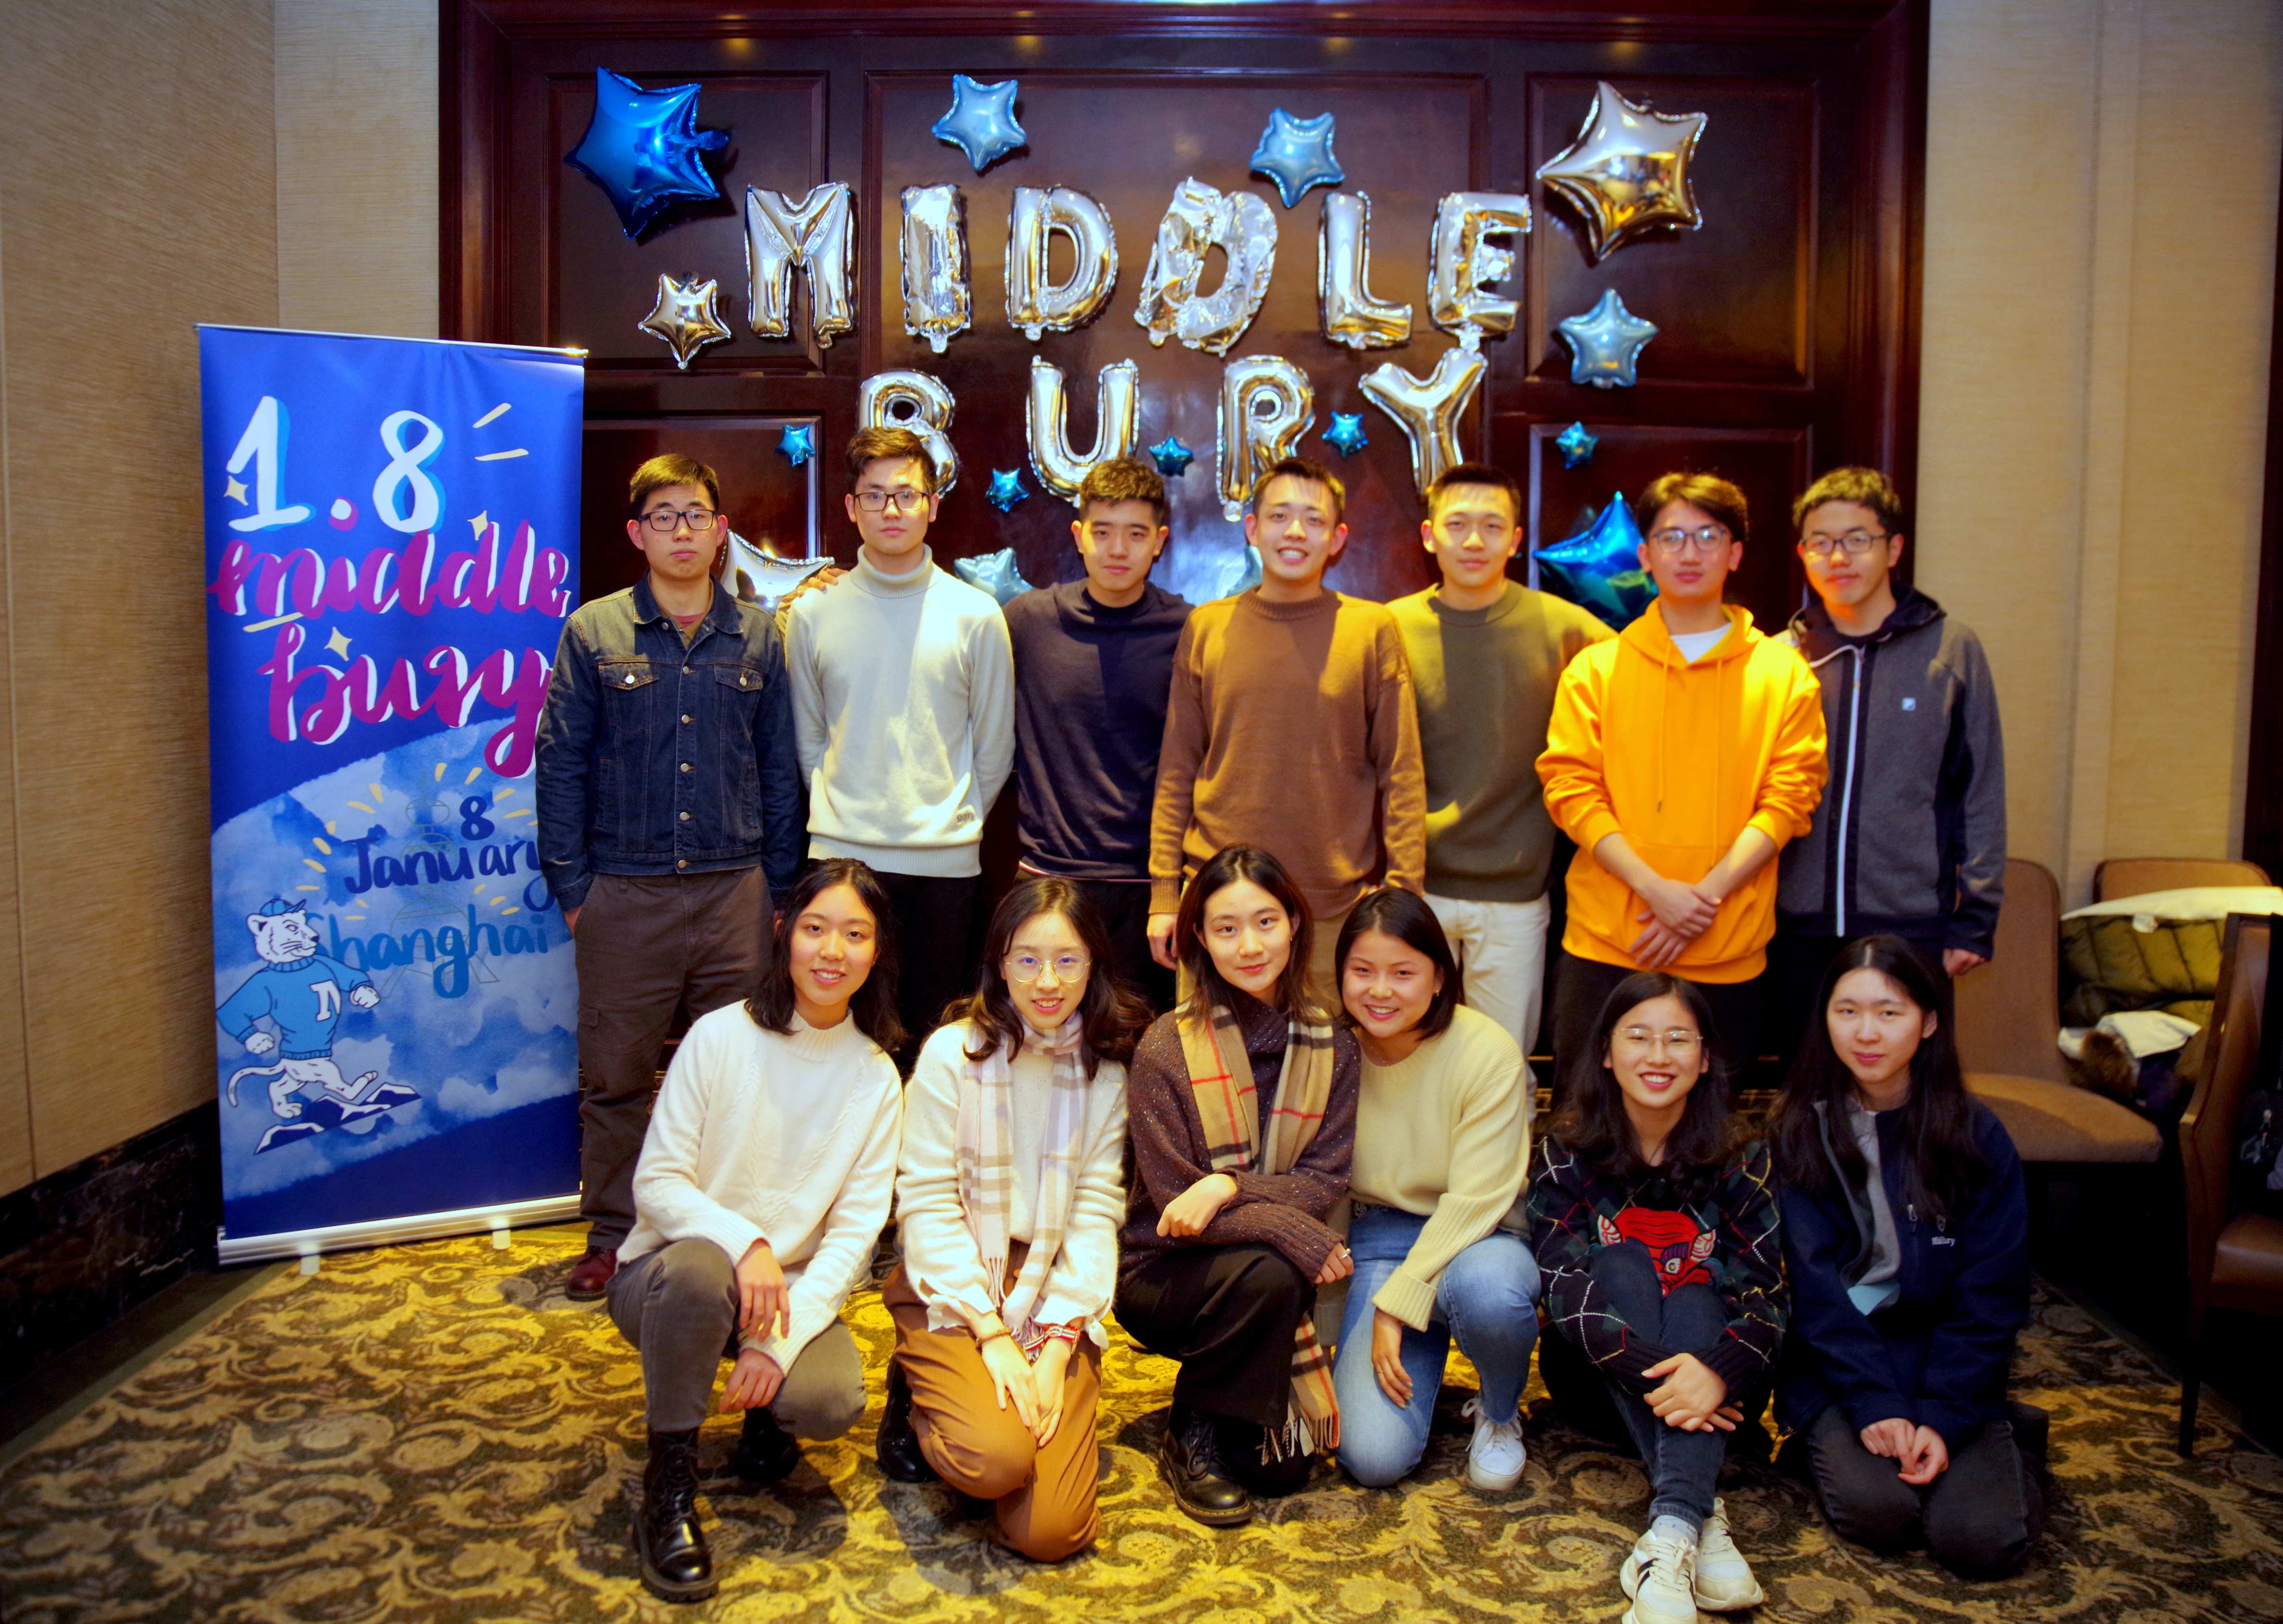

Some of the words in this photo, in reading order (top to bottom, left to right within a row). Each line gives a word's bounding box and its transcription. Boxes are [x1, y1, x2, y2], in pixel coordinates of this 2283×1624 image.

[744, 177, 1532, 356] MIDDLE
[226, 396, 445, 533] 1.8
[857, 349, 1488, 514] BURY
[207, 520, 572, 619] middle
[258, 623, 553, 778] bury
[342, 837, 556, 912] January
[460, 796, 495, 840] 8
